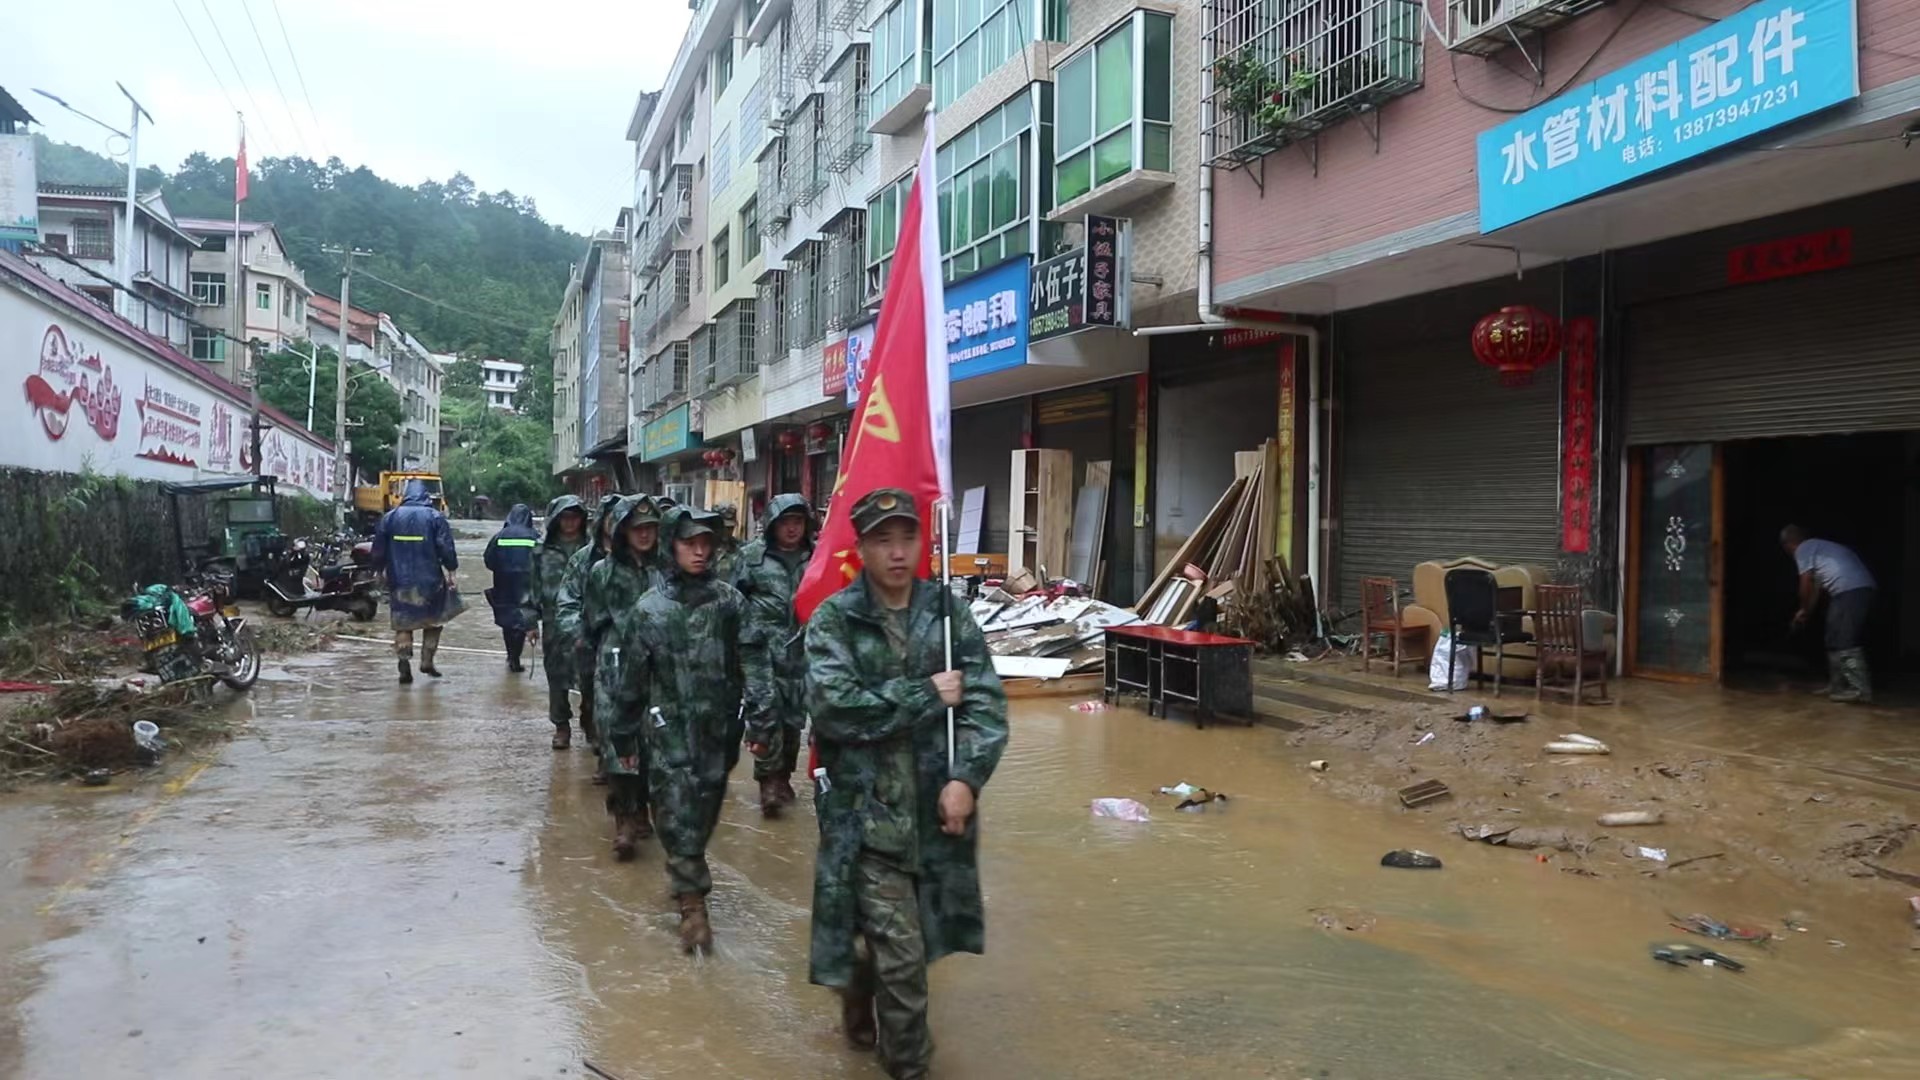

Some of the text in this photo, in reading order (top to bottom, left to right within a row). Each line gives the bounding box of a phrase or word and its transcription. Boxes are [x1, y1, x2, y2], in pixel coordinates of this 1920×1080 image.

[1501, 7, 1807, 185] 水管材料配件
[1673, 80, 1799, 144] 13873947231
